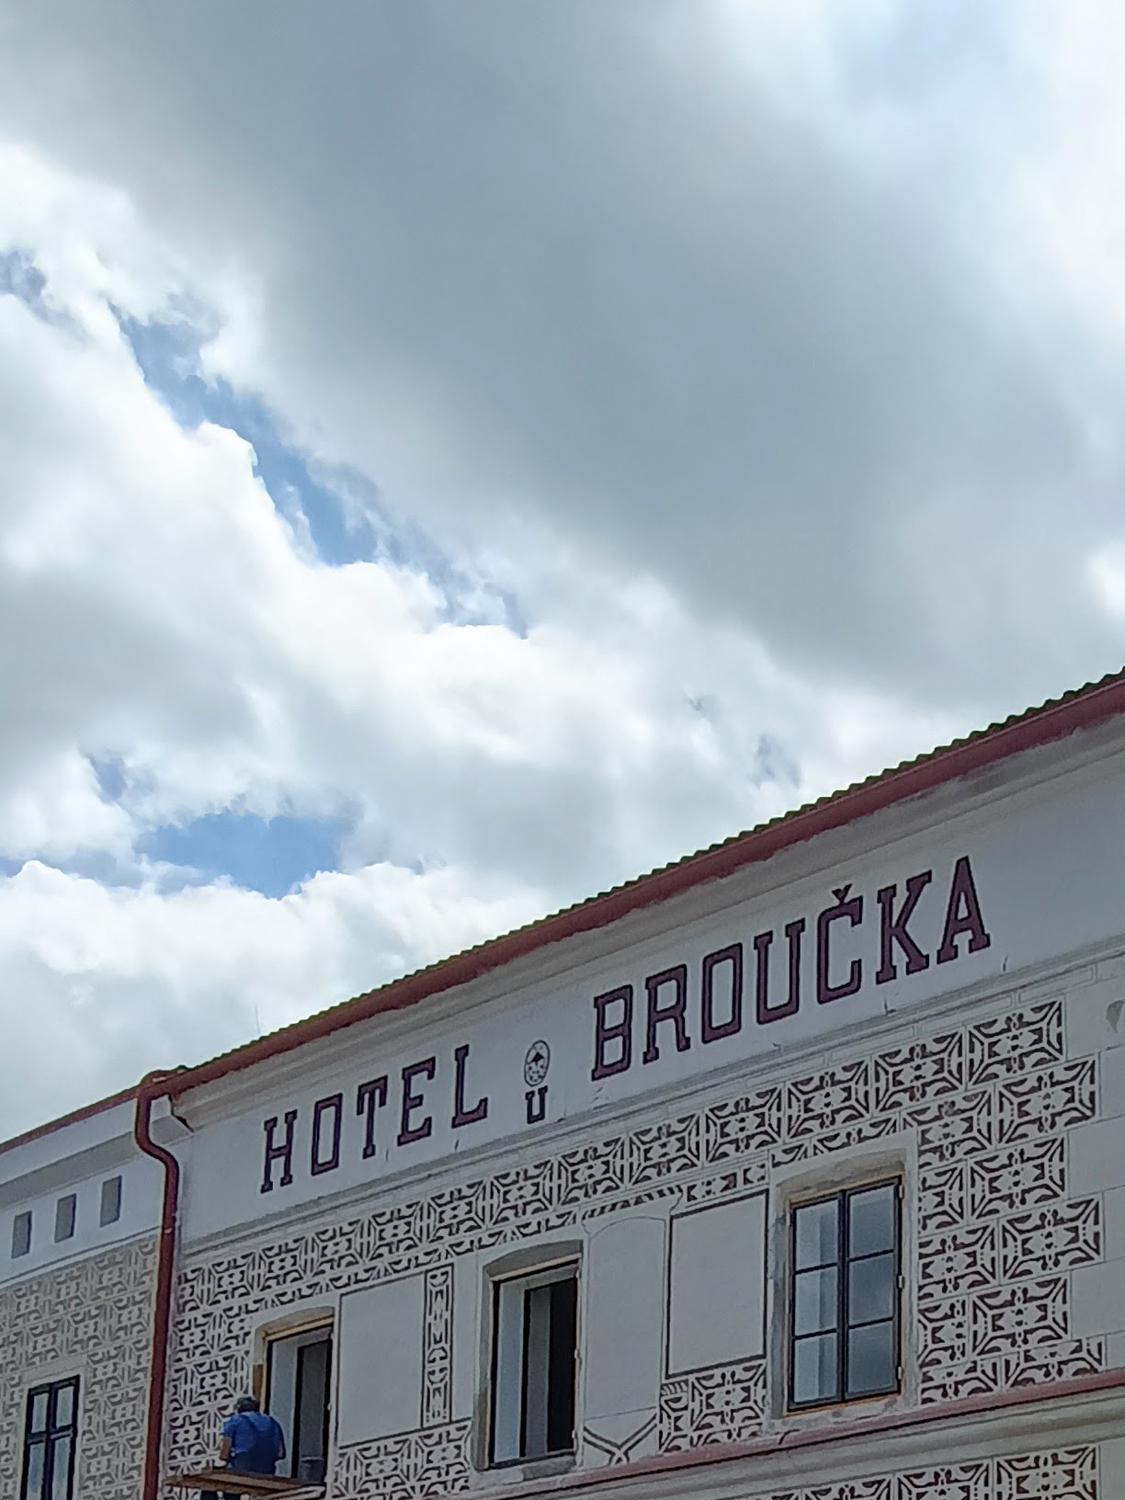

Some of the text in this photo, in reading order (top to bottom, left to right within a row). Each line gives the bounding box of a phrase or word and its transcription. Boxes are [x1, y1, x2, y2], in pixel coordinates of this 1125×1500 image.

[260, 855, 992, 1194] HOTEL U BROUČKA
